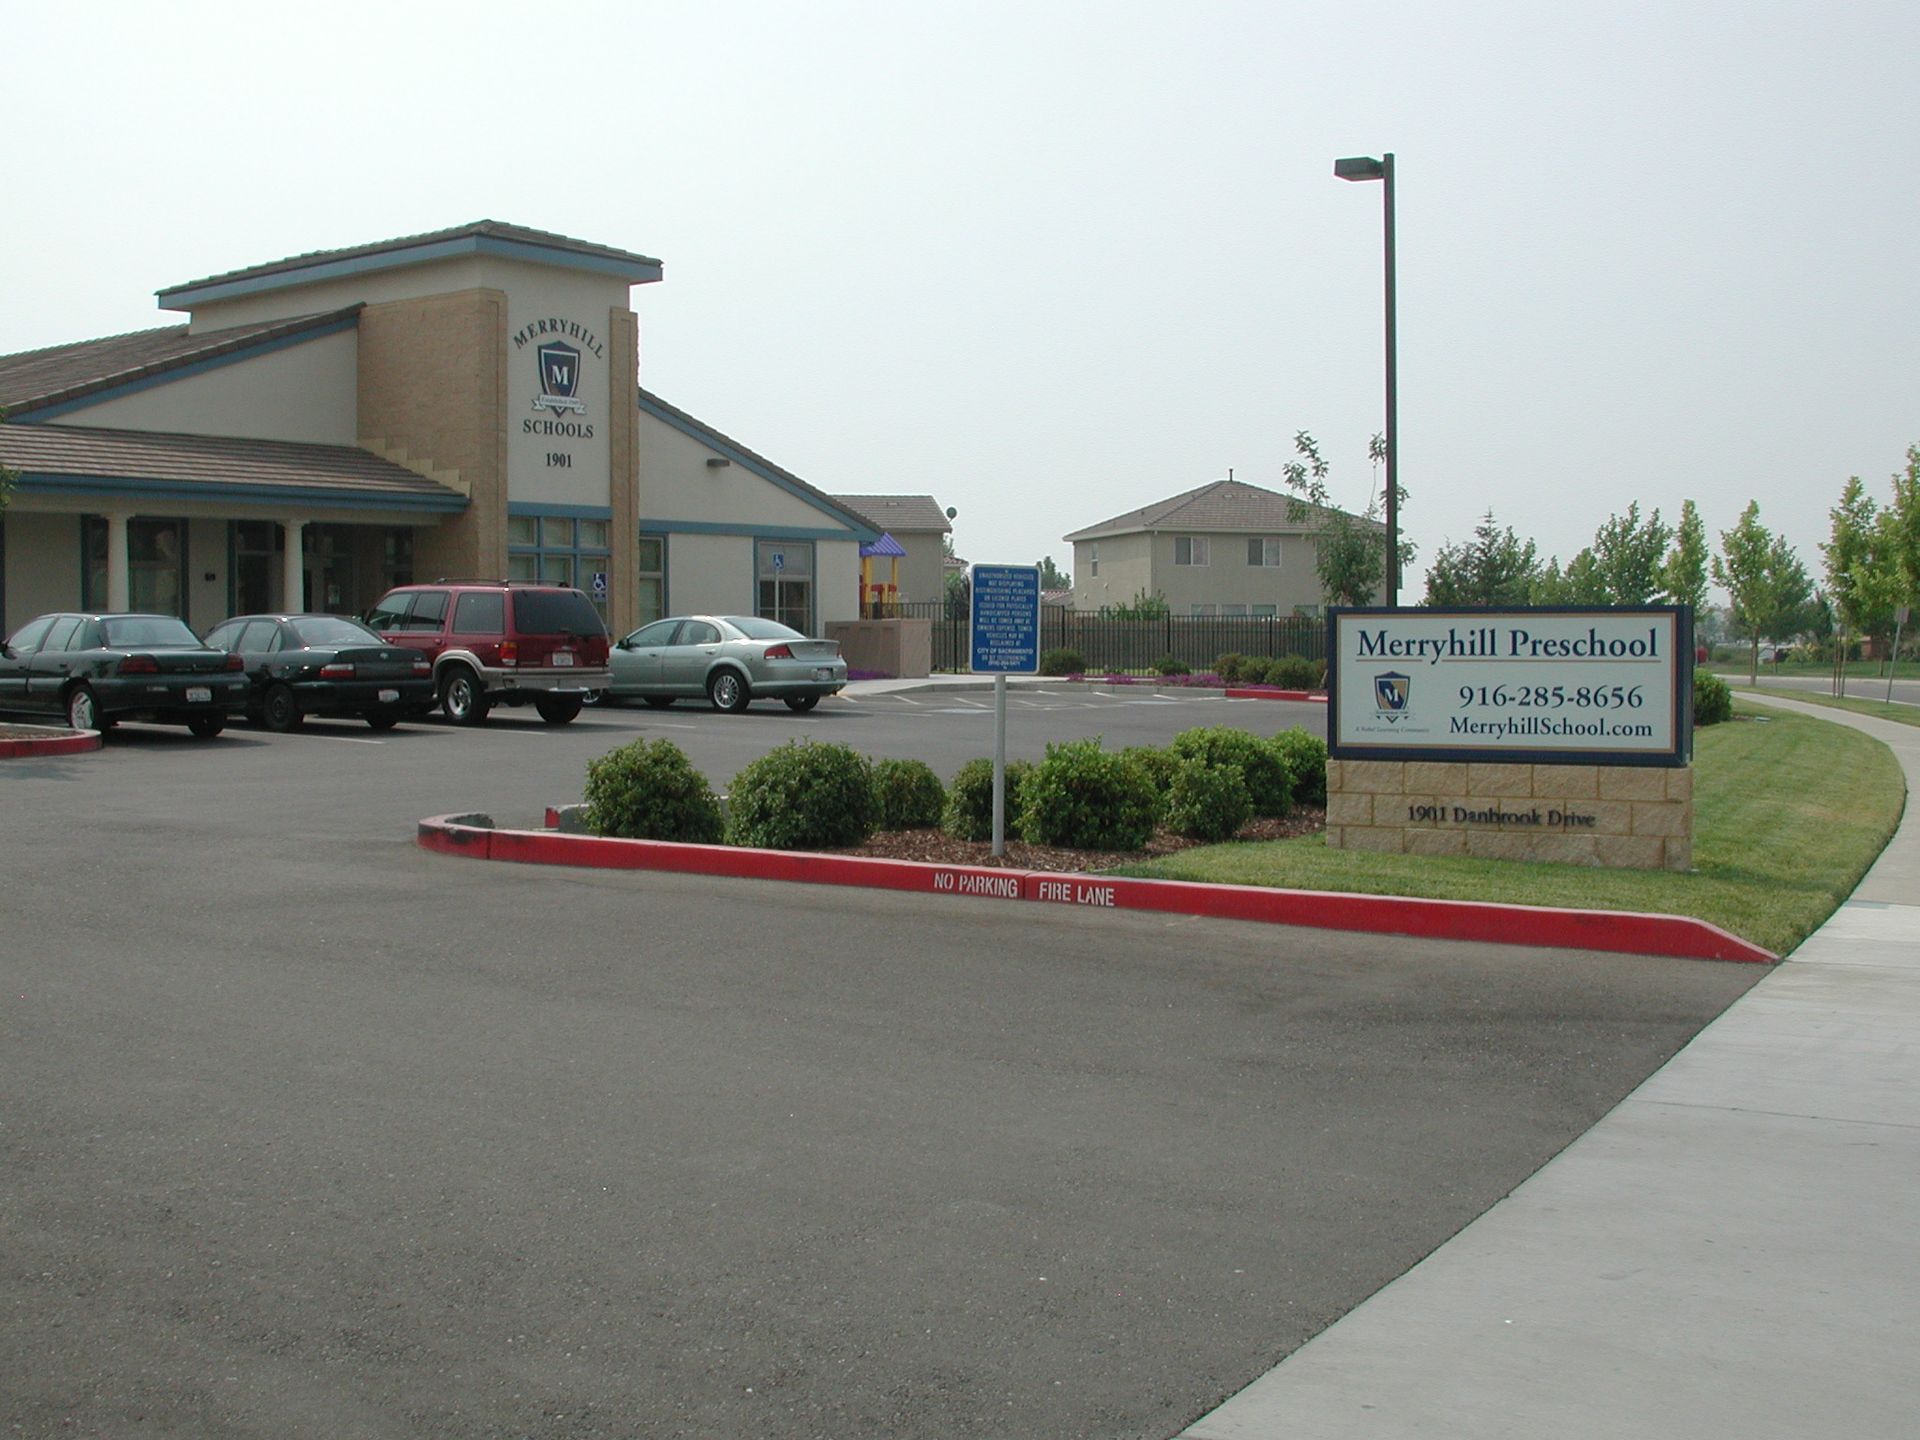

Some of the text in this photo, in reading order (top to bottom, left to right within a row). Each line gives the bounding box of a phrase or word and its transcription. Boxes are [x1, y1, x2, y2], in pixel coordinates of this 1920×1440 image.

[513, 318, 604, 359] MERRYHILL
[552, 365, 569, 385] M
[523, 419, 594, 439] SCHOOLS
[546, 453, 572, 468] 1901
[1356, 627, 1658, 665] Merryhill Preschool
[1384, 687, 1398, 702] M
[1460, 684, 1643, 708] 916-285-8656
[1450, 716, 1653, 739] MerryhillSchool.com
[1408, 805, 1596, 827] 1901 Danbrook Drive
[934, 873, 1018, 898] NO PARKING
[1038, 882, 1115, 906] FIRE LANE
